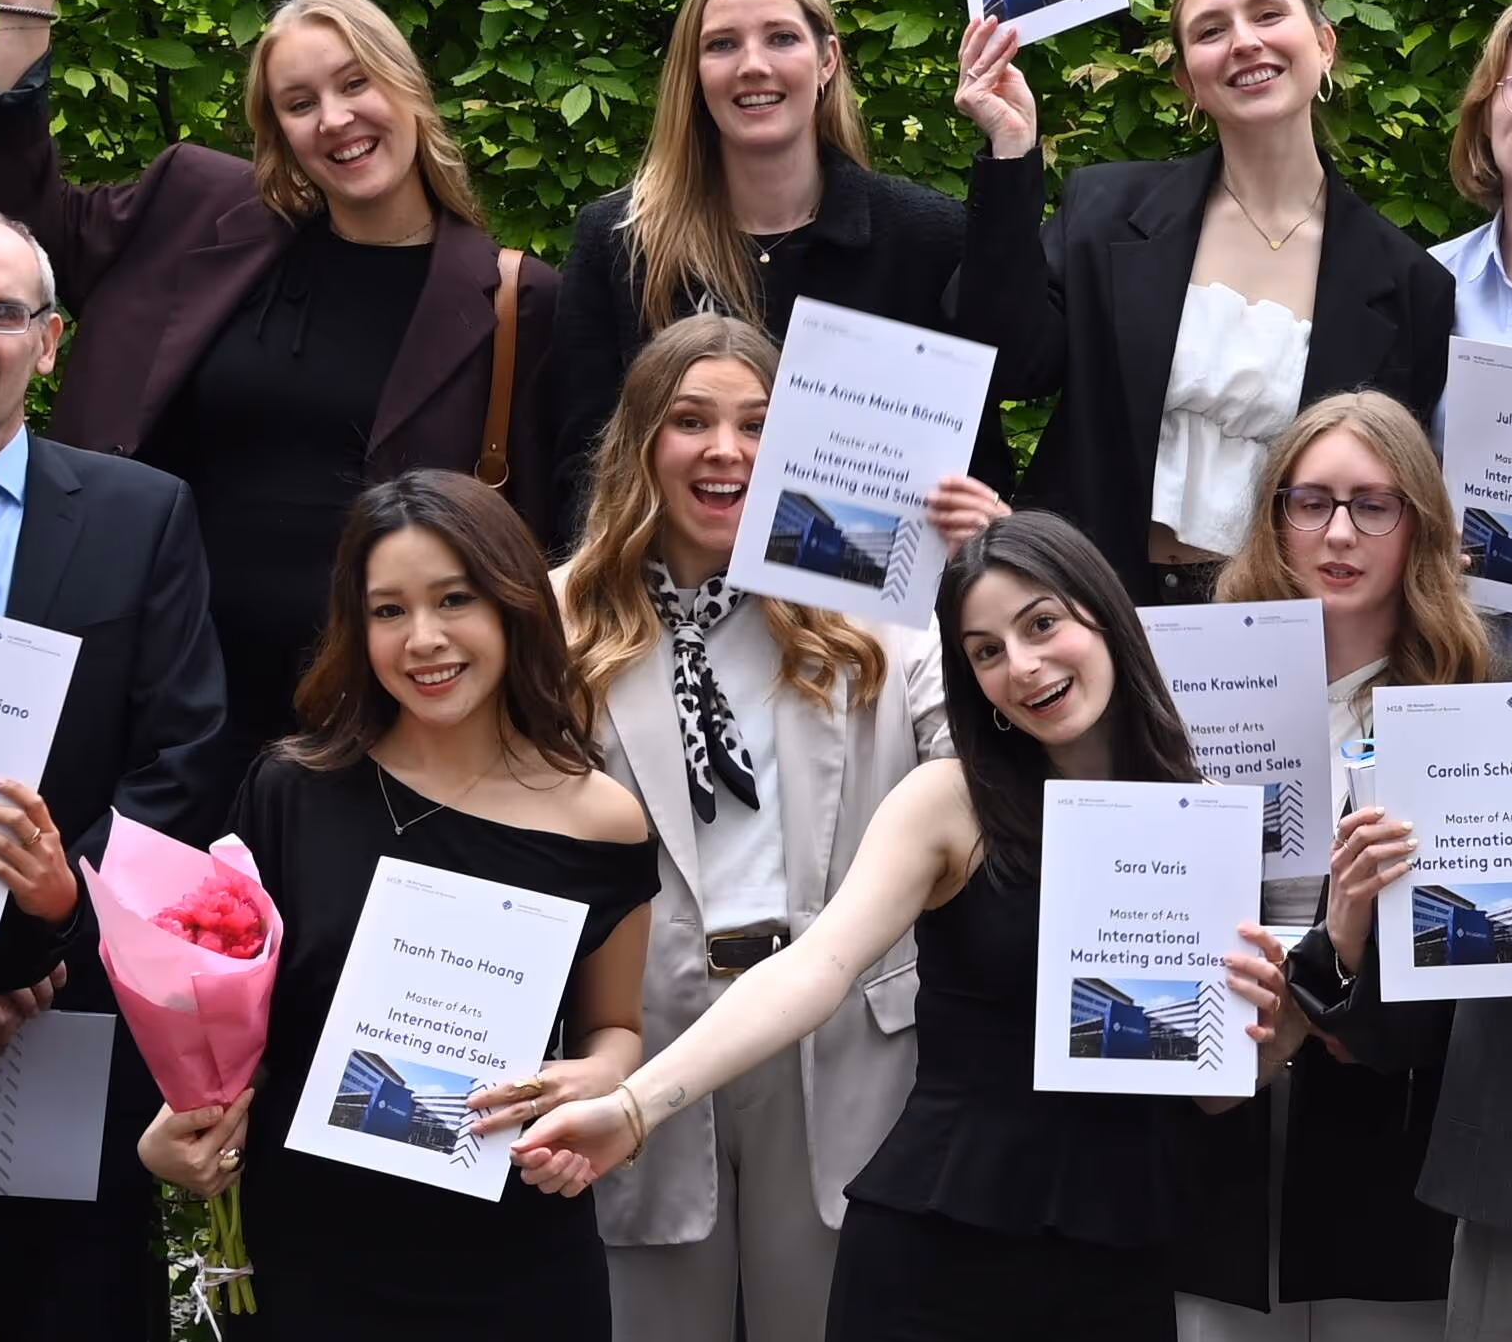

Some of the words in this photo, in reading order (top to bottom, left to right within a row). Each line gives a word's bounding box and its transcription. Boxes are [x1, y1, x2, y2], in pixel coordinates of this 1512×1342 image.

[789, 373, 827, 394] Merle
[828, 384, 866, 406] Anna
[868, 393, 909, 416] Maria
[911, 404, 964, 433] Börding
[828, 430, 865, 452] Master
[867, 442, 880, 454] of
[881, 443, 904, 460] Arts
[813, 446, 910, 484] International
[783, 460, 858, 495] Marketing
[861, 482, 891, 500] and
[1172, 679, 1207, 693] Elena
[1210, 674, 1278, 691] Krawinkel
[1190, 724, 1226, 735] Master
[1228, 722, 1240, 734] of
[1241, 722, 1265, 733] Arts
[1195, 738, 1276, 757] ternational
[1234, 758, 1263, 775] and
[1265, 756, 1302, 772] Sales
[1426, 762, 1480, 779] Carolin
[1445, 813, 1485, 825] Master
[1487, 811, 1500, 823] of
[1114, 859, 1147, 874] Sara
[1151, 860, 1187, 876] Varis
[1408, 854, 1489, 873] Marketing
[1109, 908, 1149, 921] Master
[1151, 909, 1164, 921] of
[1165, 910, 1190, 922] Arts
[1098, 928, 1200, 945] International
[393, 937, 436, 960] Thanh
[440, 948, 474, 969] Thao
[476, 958, 525, 985] Hoang
[1070, 948, 1149, 969] Marketing
[1154, 951, 1183, 966] and
[1187, 952, 1226, 967] Sales
[405, 990, 444, 1008] Master
[445, 1001, 459, 1012] of
[458, 1004, 482, 1019] Arts
[387, 1007, 489, 1044] International
[355, 1021, 433, 1055] Marketing
[436, 1044, 467, 1059] and
[467, 1048, 507, 1070] Sales
